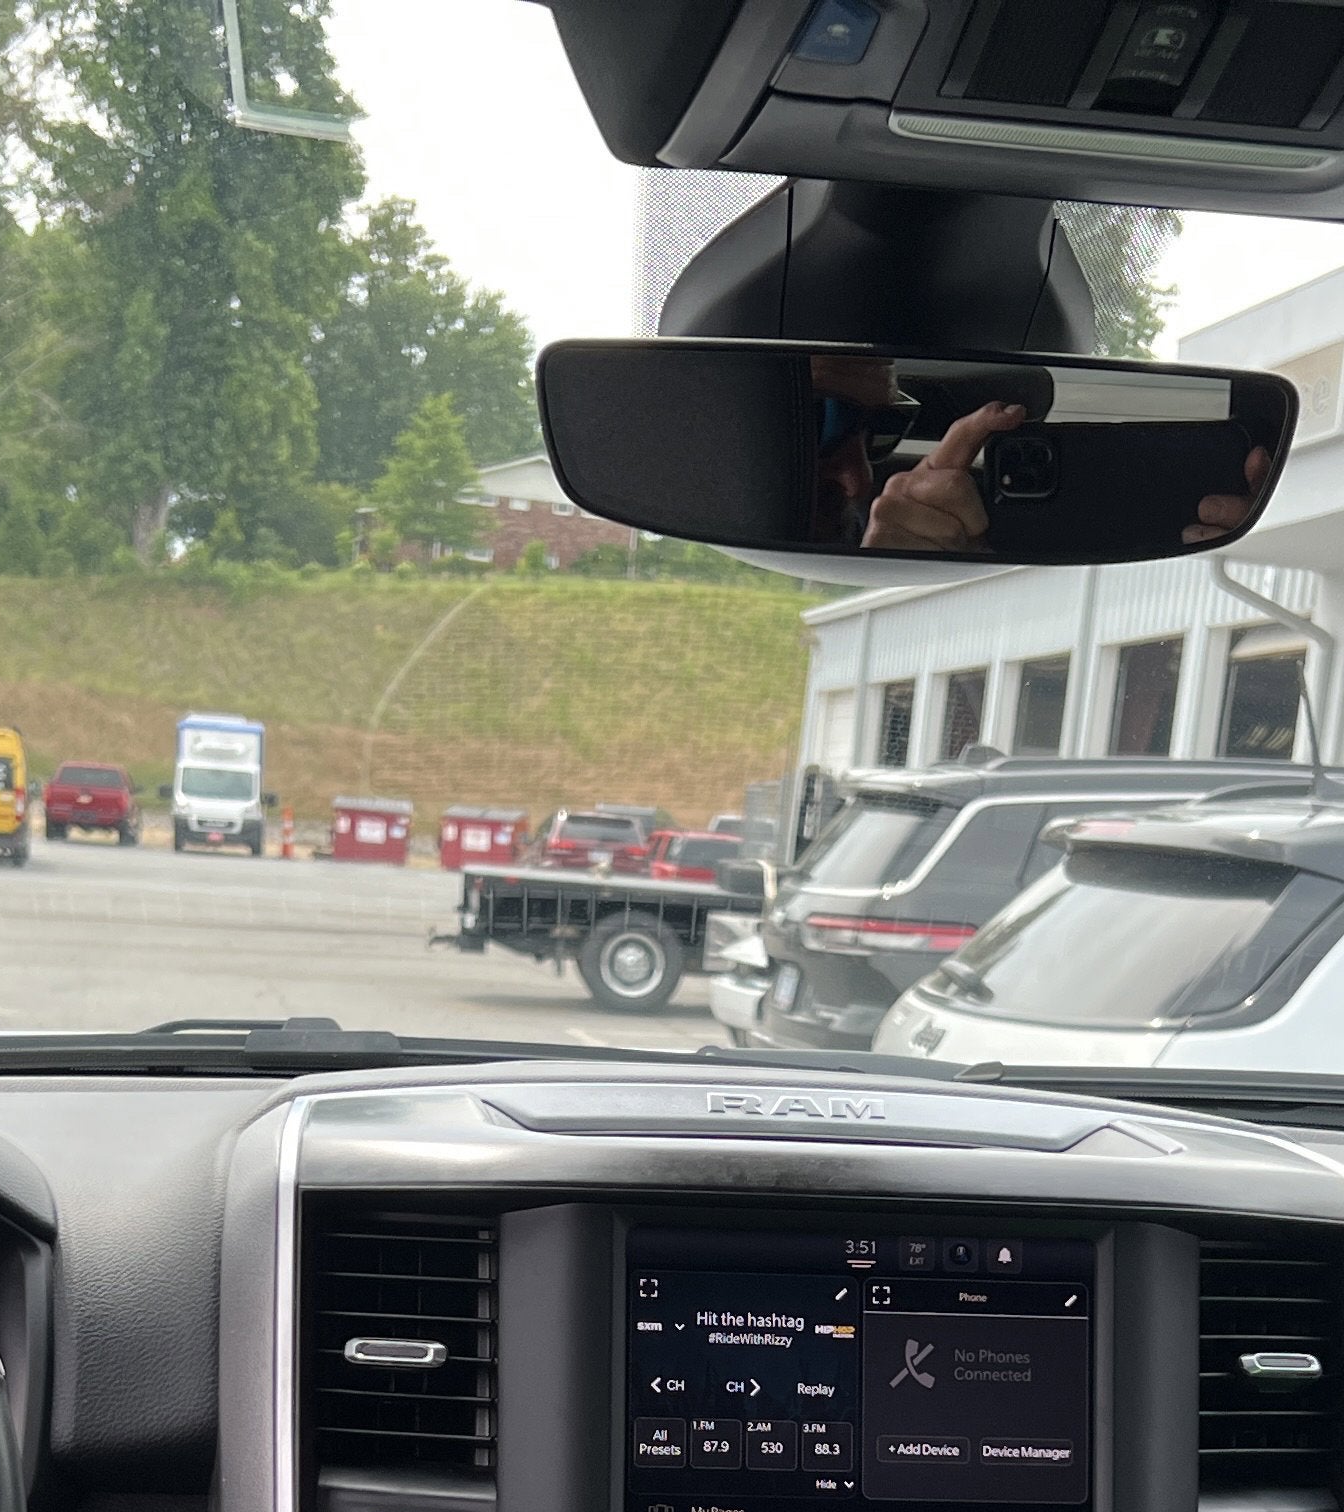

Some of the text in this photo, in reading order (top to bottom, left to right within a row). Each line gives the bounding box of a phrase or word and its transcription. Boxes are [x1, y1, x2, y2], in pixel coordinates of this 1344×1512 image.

[706, 1091, 886, 1120] RAM
[845, 1239, 877, 1254] 3:51
[959, 1292, 988, 1303] Phone
[696, 1311, 805, 1332] Hit the hashtag
[708, 1333, 793, 1348] #RideWithRizzy
[954, 1349, 1031, 1364] No Phones
[954, 1367, 1032, 1382] Connected
[666, 1379, 685, 1391] CH
[725, 1381, 745, 1393] CH
[797, 1383, 835, 1397] Replay
[652, 1429, 668, 1441] All
[639, 1444, 681, 1456] Presets
[702, 1440, 730, 1453] 87.9
[760, 1441, 784, 1454] 530
[814, 1443, 840, 1456] 88.3
[897, 1443, 921, 1456] Add
[922, 1444, 960, 1457] Device
[982, 1445, 1071, 1461] Device Manager
[815, 1479, 837, 1490] Hide
